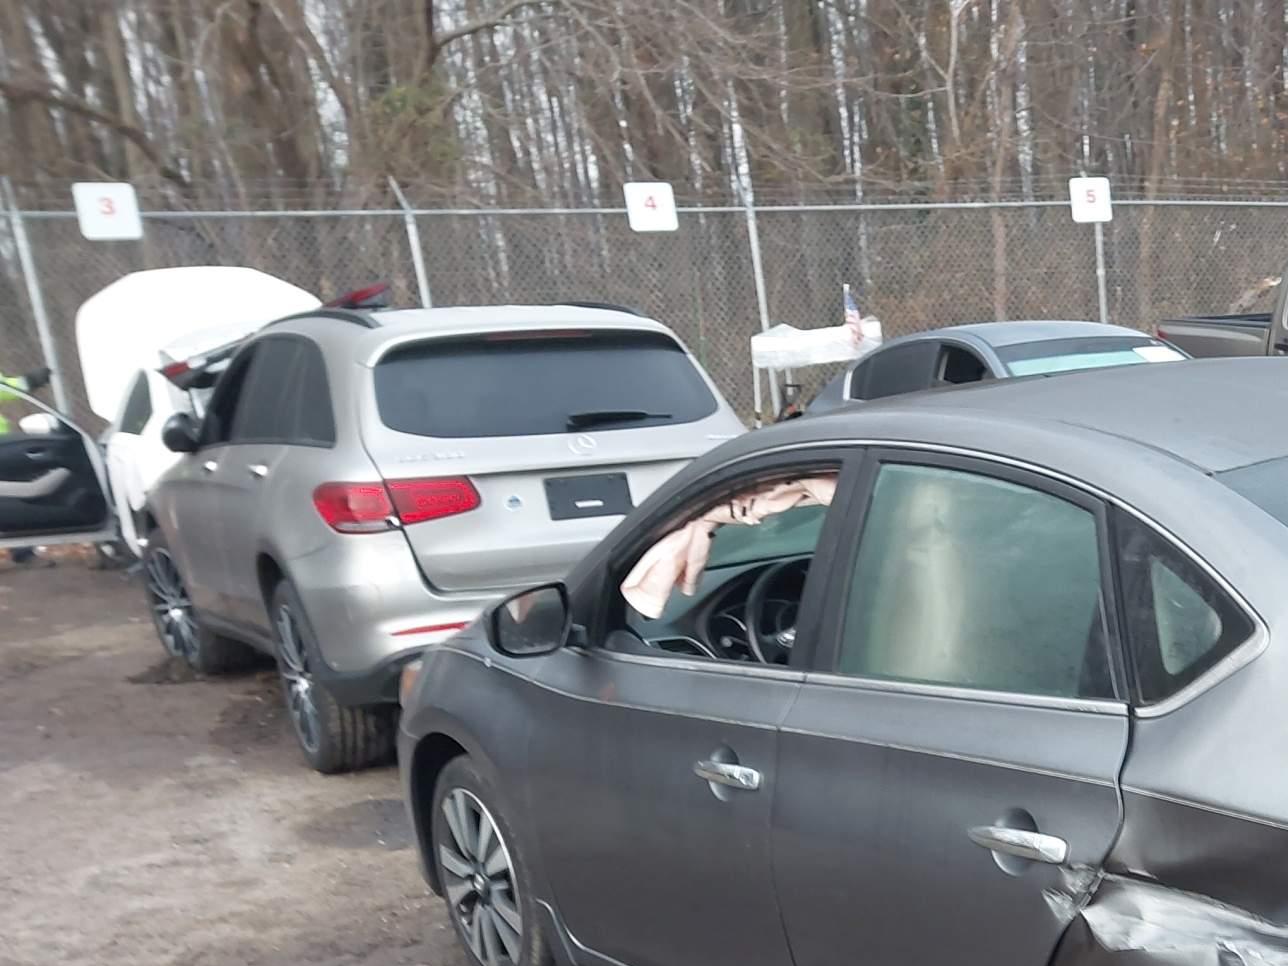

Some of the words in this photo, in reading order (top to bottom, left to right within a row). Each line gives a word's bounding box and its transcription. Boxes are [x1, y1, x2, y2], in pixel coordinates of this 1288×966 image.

[643, 195, 658, 210] 4
[1086, 189, 1097, 204] 5
[98, 196, 118, 216] 3
